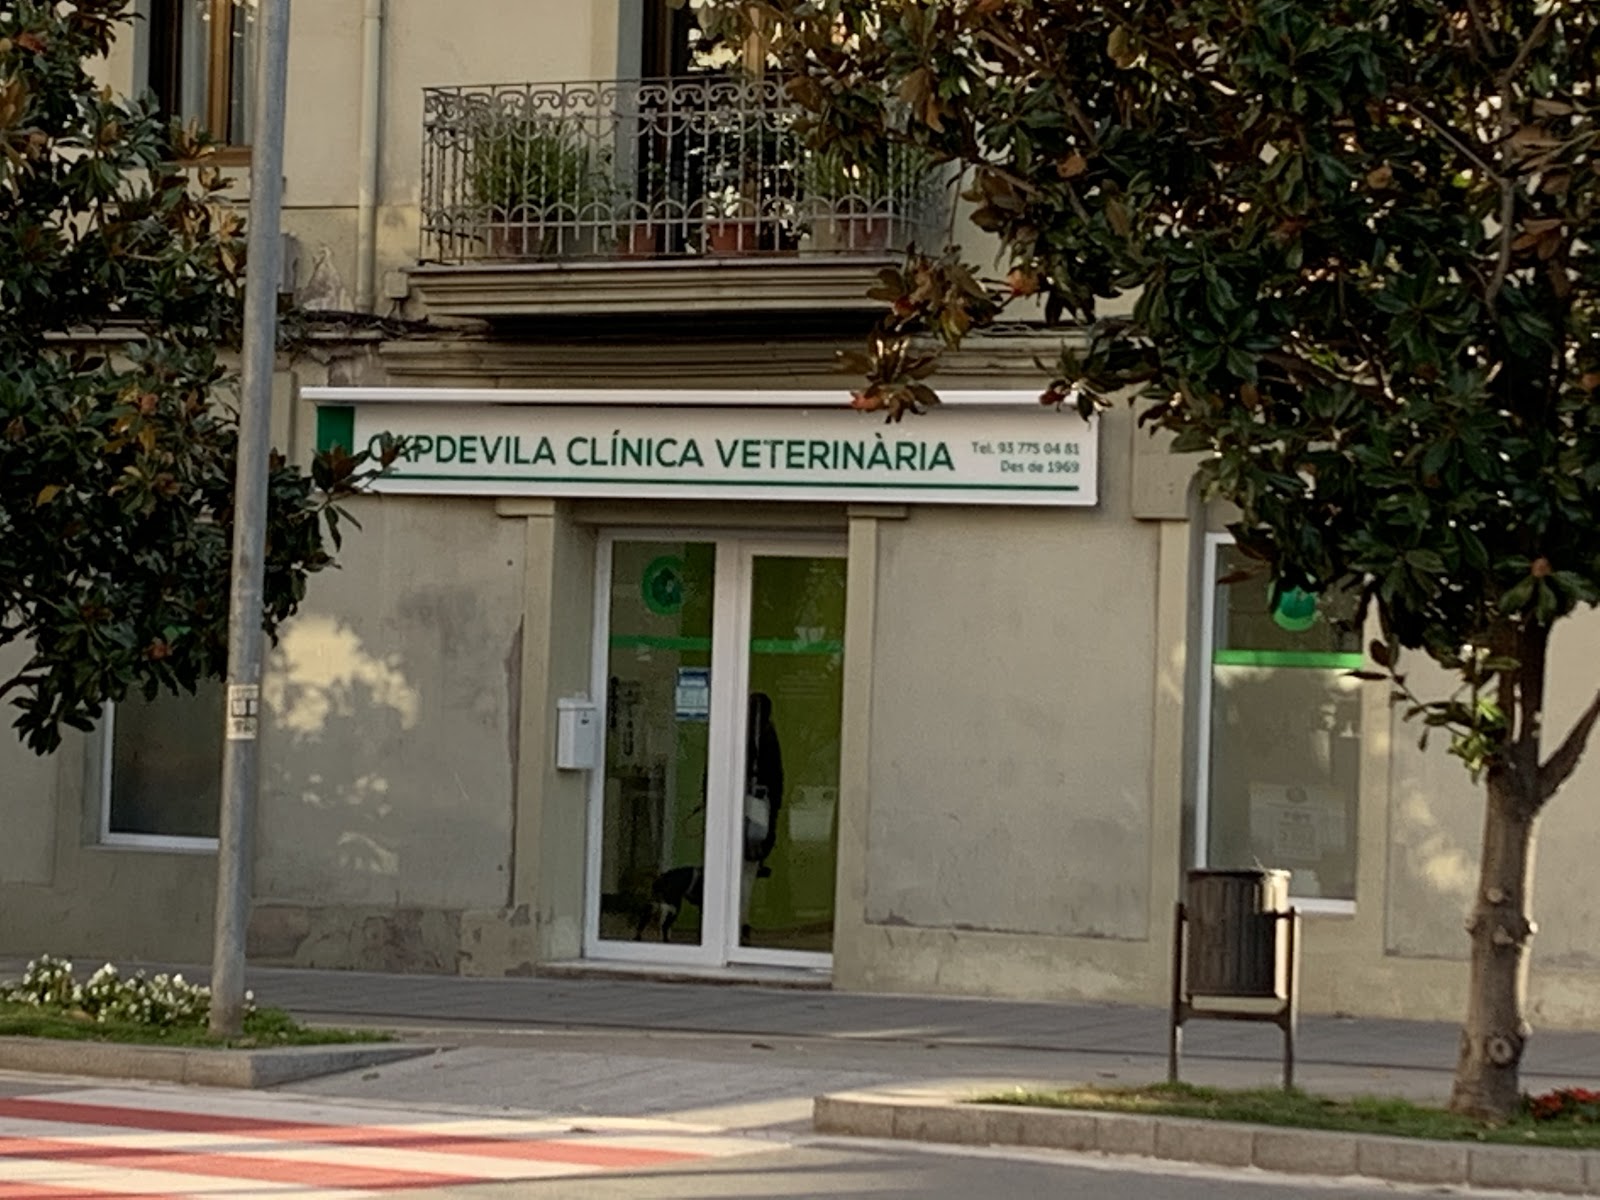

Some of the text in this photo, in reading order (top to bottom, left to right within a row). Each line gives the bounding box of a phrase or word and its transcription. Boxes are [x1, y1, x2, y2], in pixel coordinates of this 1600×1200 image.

[567, 429, 704, 468] CLÍNICA
[715, 432, 955, 472] VETERINÀRIA
[971, 441, 995, 455] Tel.
[997, 442, 1014, 454] 93
[1017, 442, 1041, 455] 775
[1027, 460, 1044, 473] de
[1047, 461, 1080, 473] 1969
